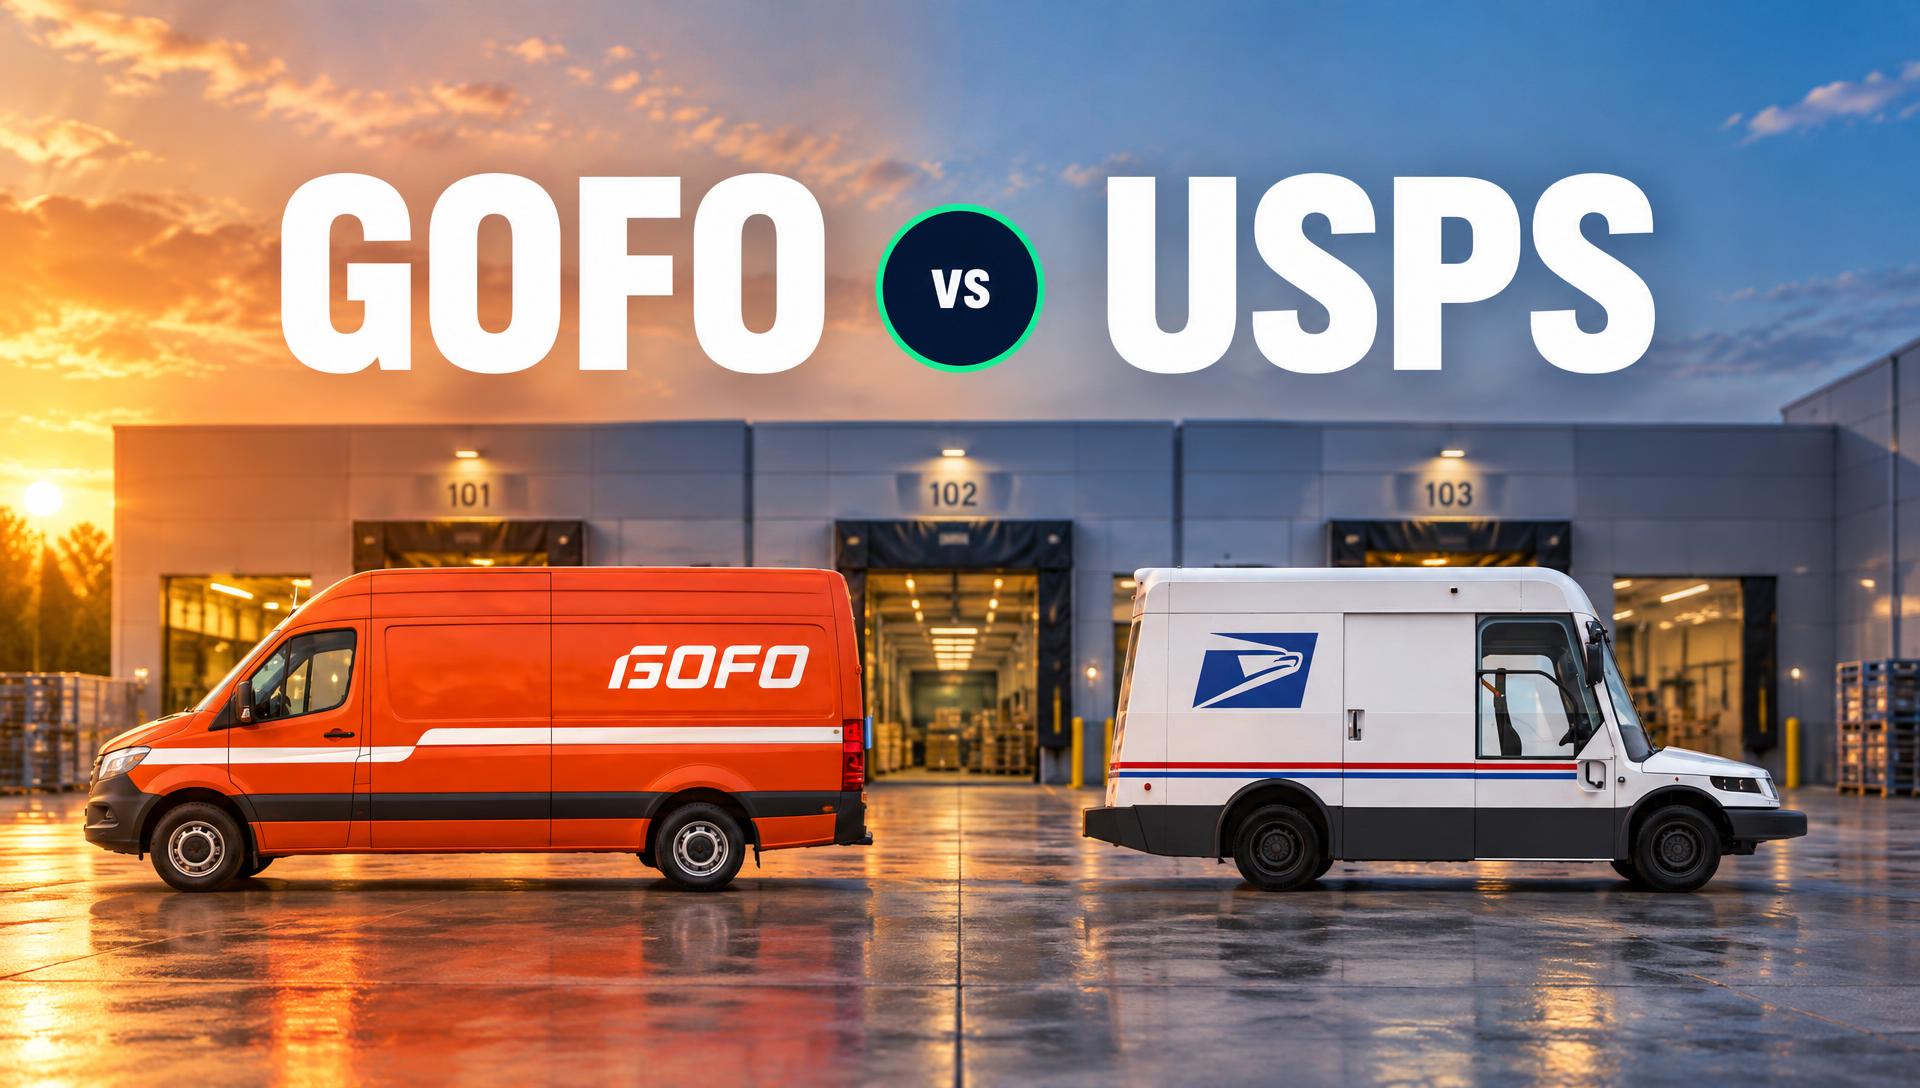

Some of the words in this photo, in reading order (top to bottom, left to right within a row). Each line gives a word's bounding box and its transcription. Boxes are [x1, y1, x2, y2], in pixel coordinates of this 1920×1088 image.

[448, 482, 490, 508] 101
[930, 481, 977, 507] 102
[1426, 481, 1473, 507] 103
[607, 644, 810, 689] GOFO
